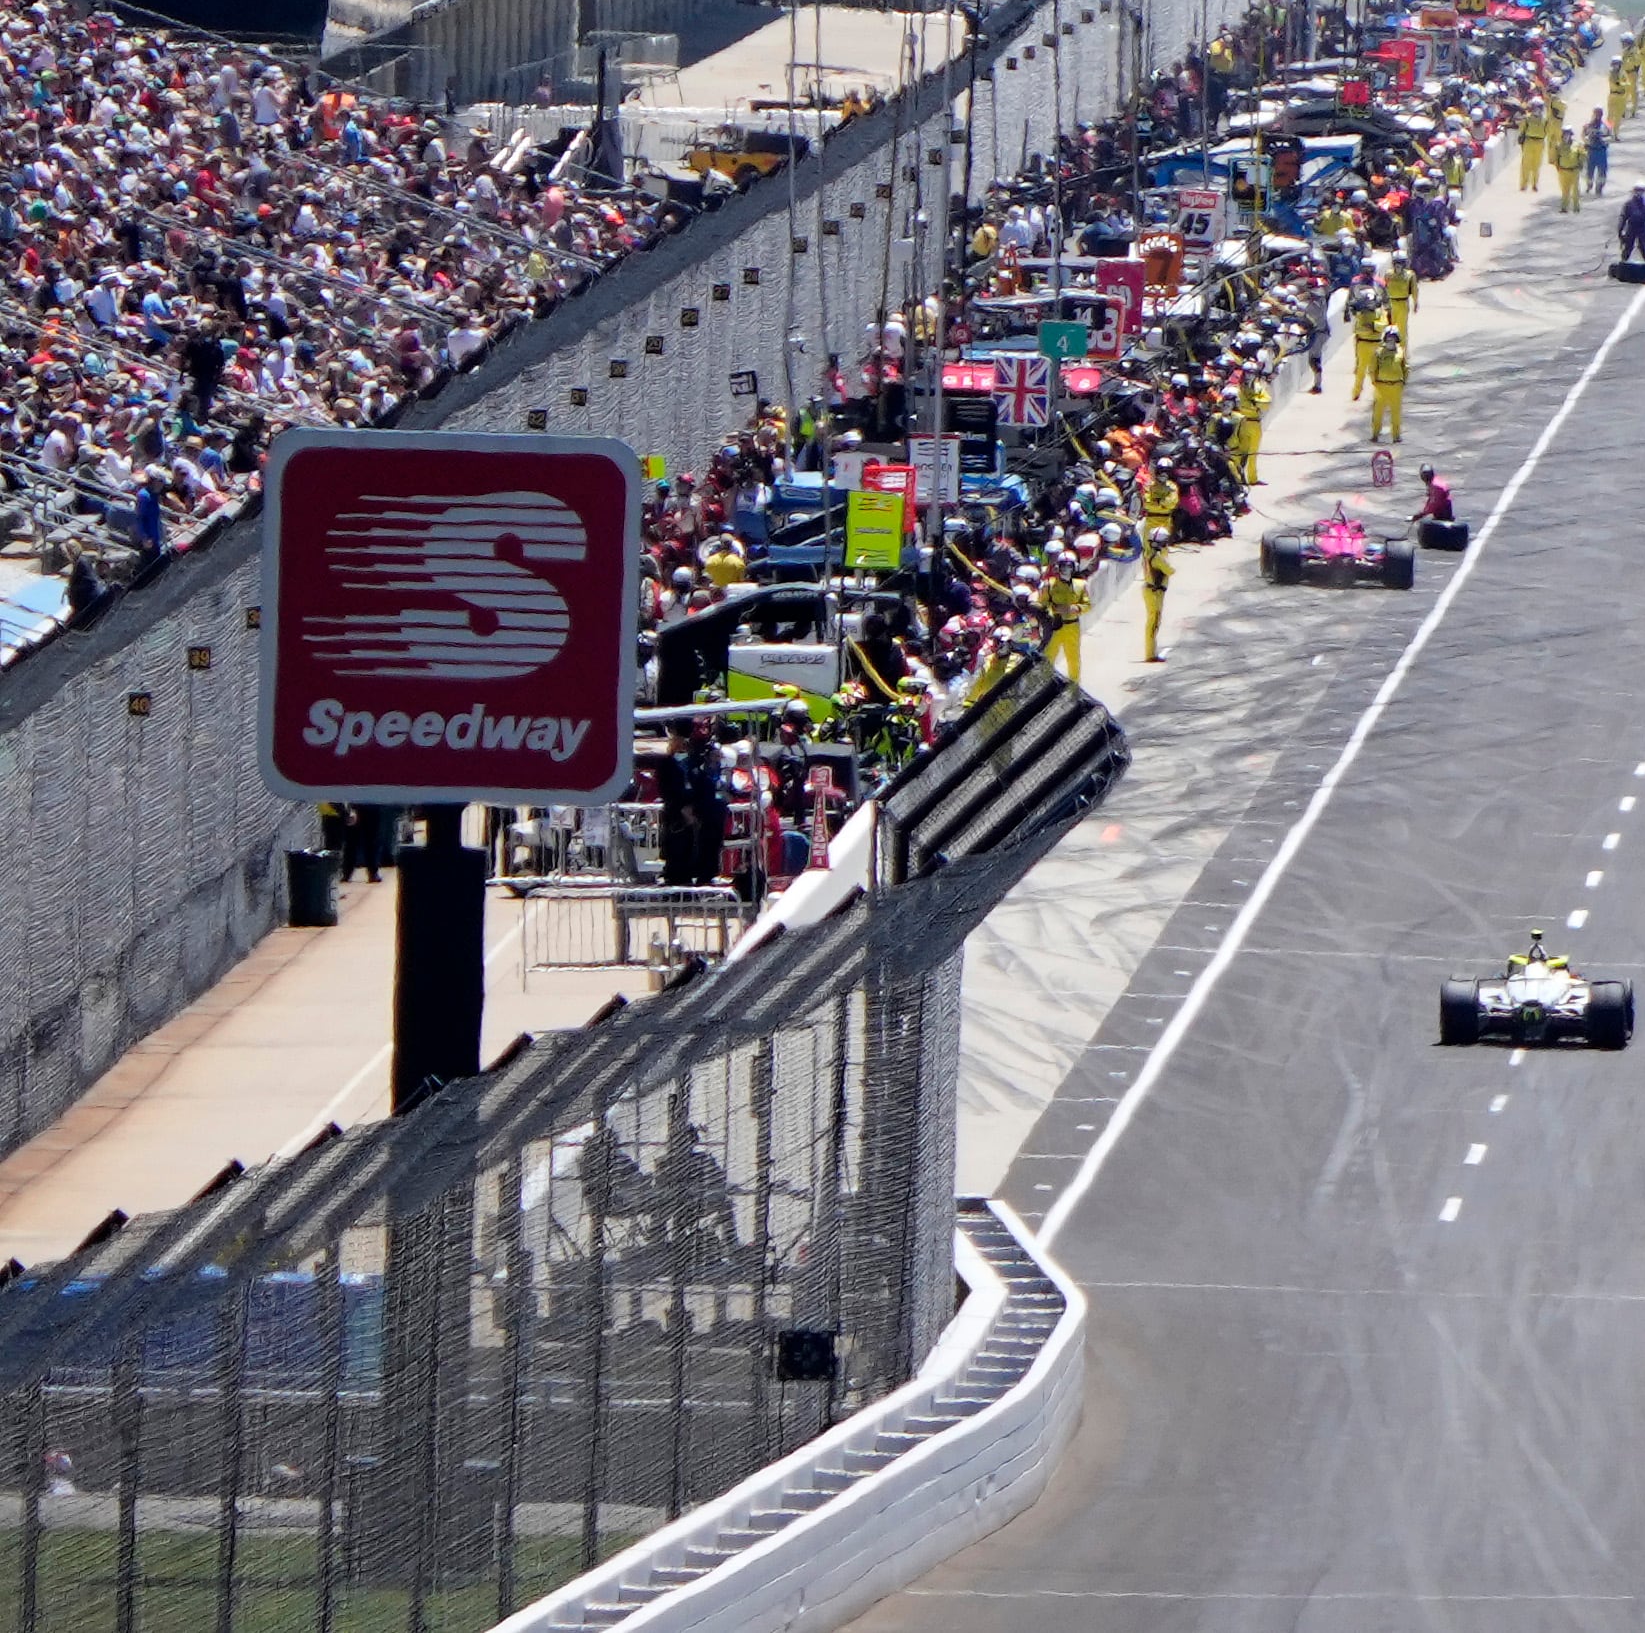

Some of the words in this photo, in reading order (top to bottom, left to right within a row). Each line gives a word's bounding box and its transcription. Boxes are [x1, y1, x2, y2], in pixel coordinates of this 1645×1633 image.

[1180, 212, 1212, 235] 45
[1056, 335, 1069, 353] 4
[131, 697, 150, 713] 40
[303, 698, 592, 762] Speedway
